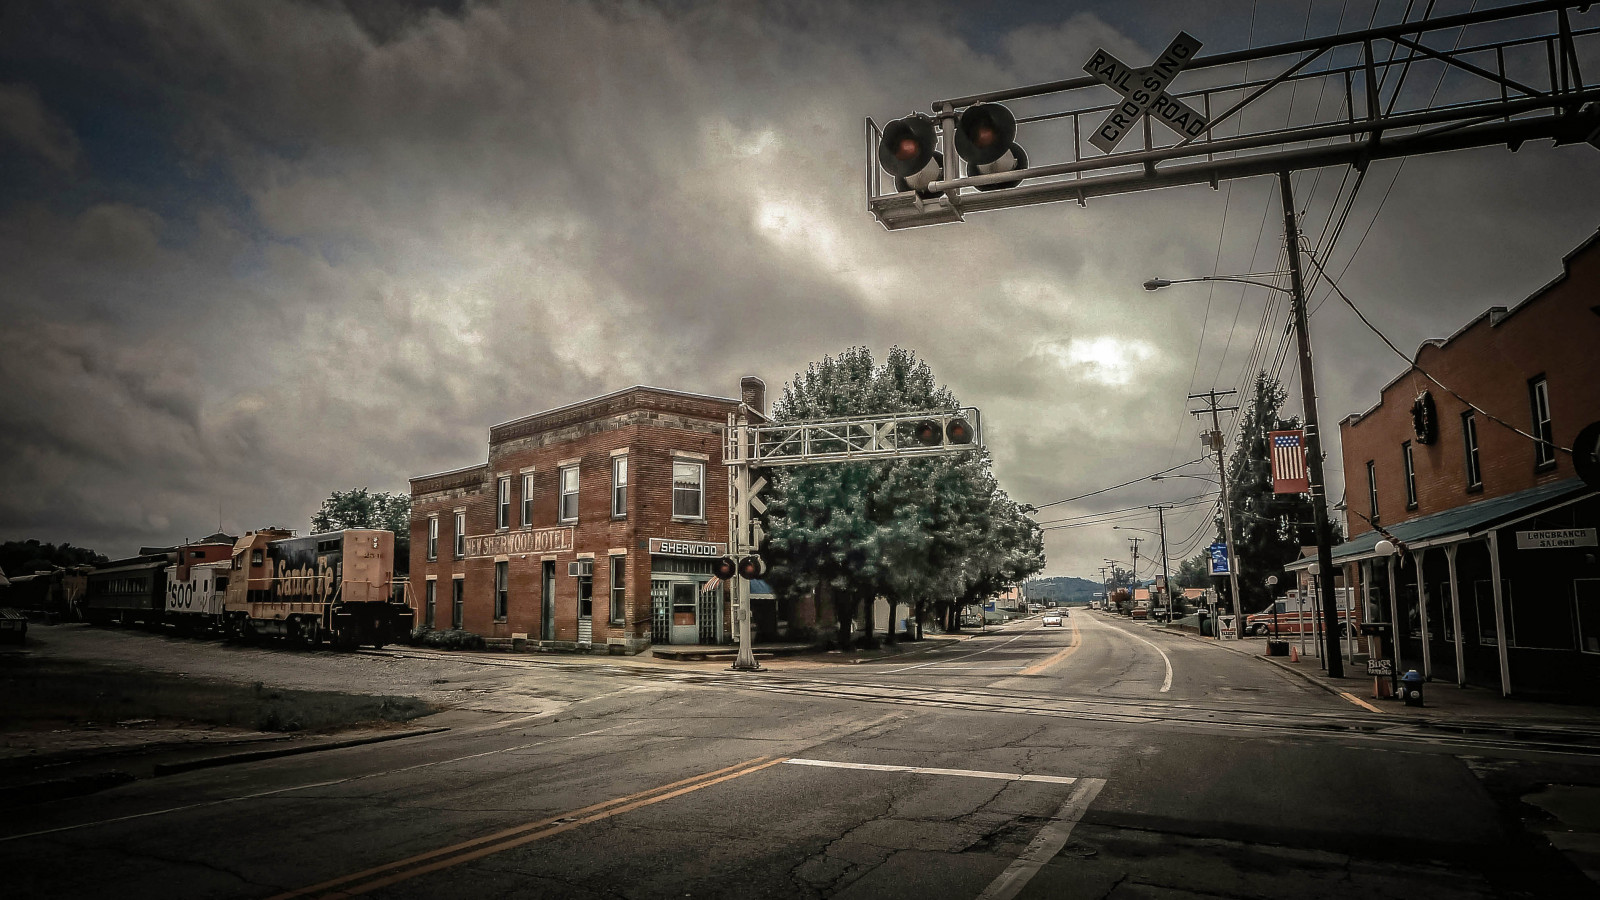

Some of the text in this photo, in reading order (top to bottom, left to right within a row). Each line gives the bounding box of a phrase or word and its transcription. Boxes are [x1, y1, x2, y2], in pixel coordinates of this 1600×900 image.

[1089, 53, 1205, 137] RAIL ROAD
[1100, 43, 1190, 142] CROSSING
[483, 532, 534, 554] SHERWOOD
[1527, 530, 1586, 540] LONGBRANCH
[1539, 539, 1575, 548] SALOON
[661, 542, 717, 556] SHERWOOD
[277, 556, 334, 597] Santa Fe
[170, 583, 193, 609] SOO
